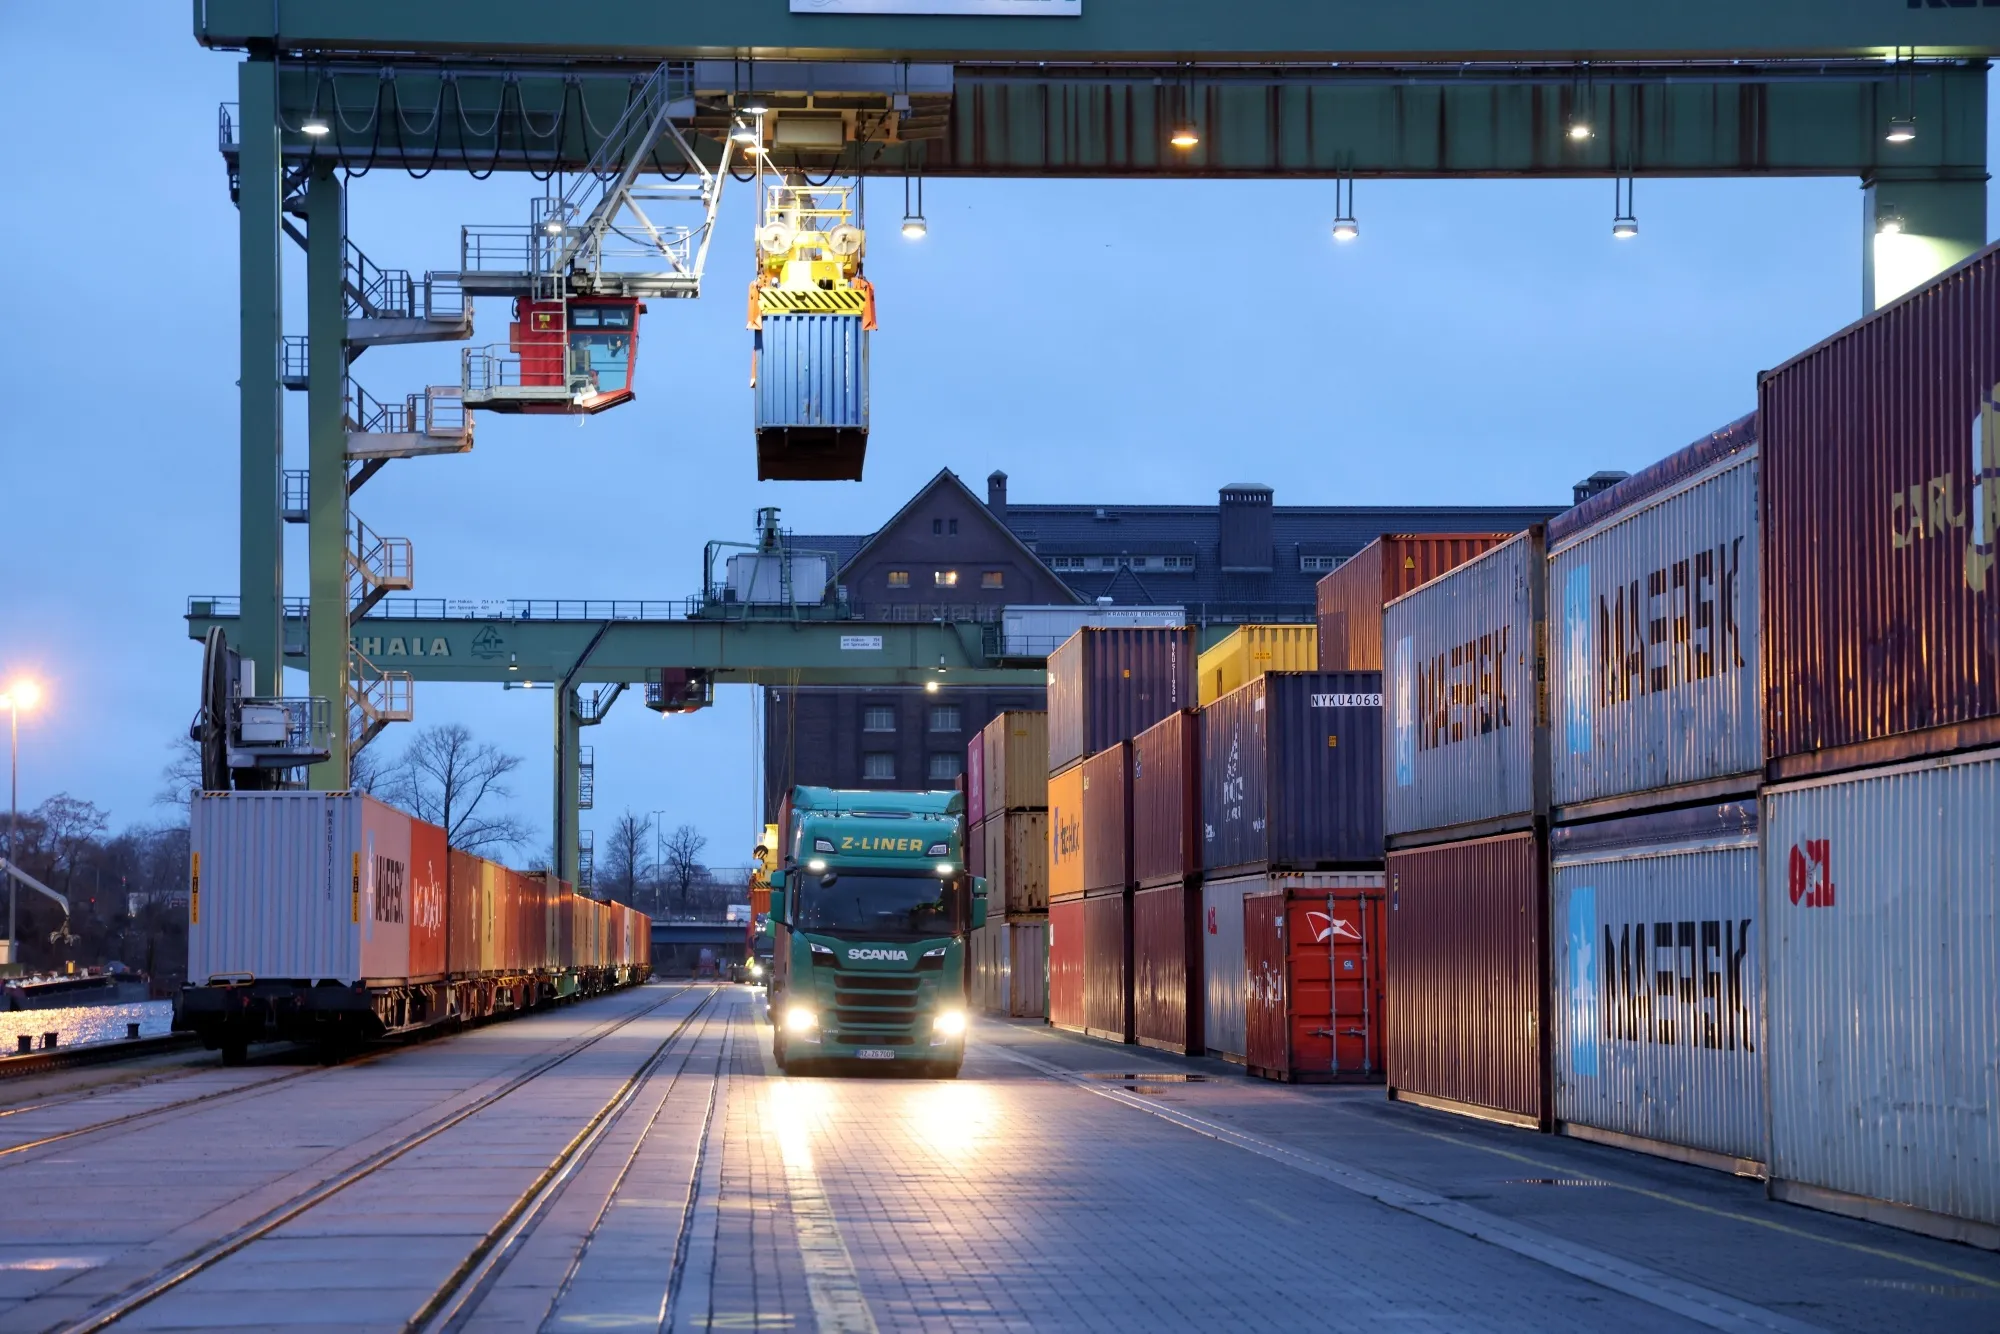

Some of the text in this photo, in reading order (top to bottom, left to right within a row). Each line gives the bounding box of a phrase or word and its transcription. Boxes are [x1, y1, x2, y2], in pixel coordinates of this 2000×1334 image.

[1600, 535, 1746, 709] MAERSK
[1312, 694, 1380, 706] NYKU4068
[841, 836, 923, 851] Z-LINER
[848, 948, 909, 961] SCANIA
[1604, 918, 1755, 1053] MAERSK
